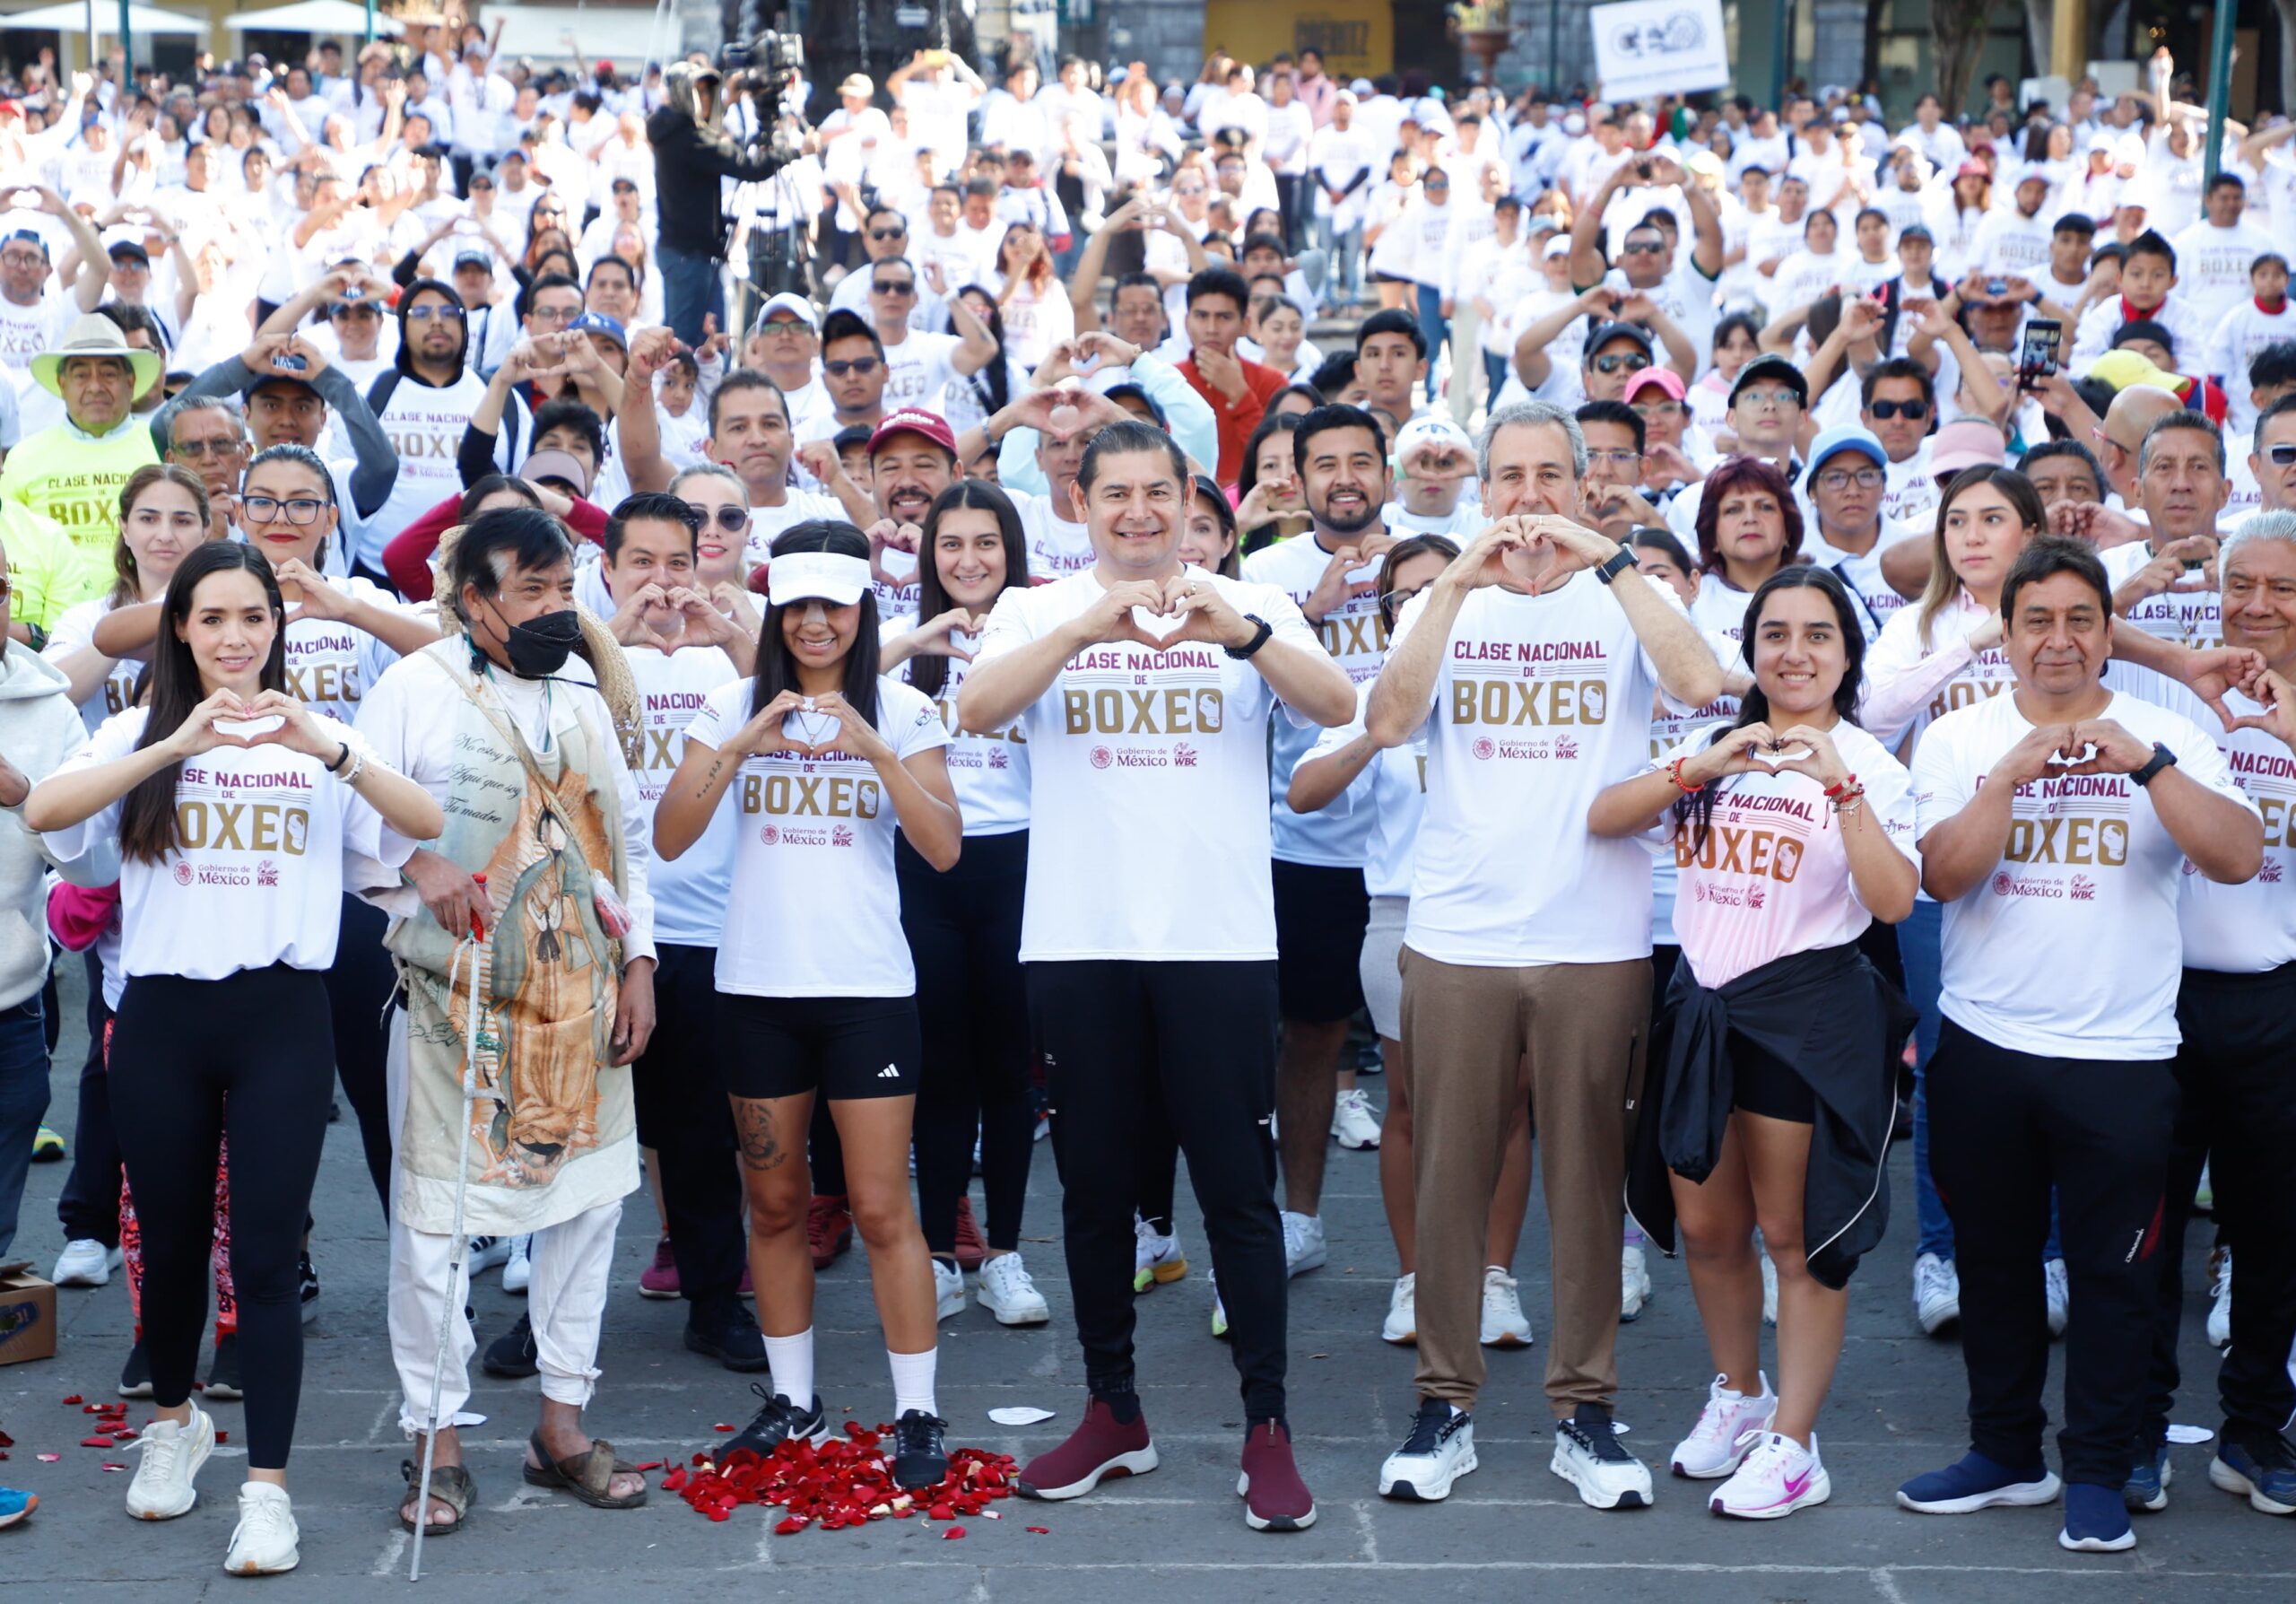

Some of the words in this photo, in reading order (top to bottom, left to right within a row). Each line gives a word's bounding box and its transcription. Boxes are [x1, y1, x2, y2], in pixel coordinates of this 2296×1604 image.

[886, 375, 926, 397] XEO
[384, 412, 422, 422] CLASE
[426, 412, 471, 424] NACION
[2231, 493, 2262, 504] CLAS
[48, 498, 114, 527] BOX
[894, 604, 905, 614] DE
[1347, 603, 1358, 614] DE
[2181, 605, 2221, 621] NACI
[1454, 641, 1513, 660] CLASE
[1518, 641, 1607, 662] NACIONAL
[288, 657, 300, 666] DE
[1065, 652, 1121, 671] CLASE
[1127, 650, 1220, 670] NACIONAL
[1523, 666, 1536, 677] DE
[1984, 669, 1996, 678] DE
[285, 664, 361, 702] XEO
[1134, 675, 1148, 685] DE
[646, 693, 706, 711] NACION
[1452, 679, 1607, 727] BOXEO
[1064, 687, 1223, 734] BOXEO
[654, 714, 665, 725] DE
[1668, 724, 1680, 734] DE
[452, 732, 486, 752] No
[476, 746, 504, 763] estoy
[1499, 739, 1537, 747] Gobierno
[1538, 739, 1549, 747] de
[1116, 747, 1155, 755] Gobierno
[1156, 747, 1168, 755] de
[1499, 746, 1548, 760] México
[1555, 749, 1578, 760] WBC
[988, 760, 1008, 770] WBC
[1117, 754, 1167, 768] México
[1174, 757, 1197, 767] WBC
[2230, 750, 2296, 780] NACION
[804, 763, 816, 773] DE
[214, 771, 313, 789] NACIONAL
[222, 789, 236, 799] DE
[504, 784, 523, 800] soy
[2042, 777, 2131, 798] NACIONAL
[744, 774, 880, 819] BOXEO
[443, 796, 469, 813] Tu
[460, 809, 502, 824] madre
[1728, 793, 1815, 823] NACIONAL
[1728, 812, 1742, 824] DE
[176, 800, 309, 857] OXEO
[782, 827, 817, 835] Gobierno
[782, 833, 826, 846] México
[832, 838, 852, 847] WBC
[2005, 817, 2129, 867] OXEO
[1674, 824, 1805, 884] BOXEO
[197, 863, 239, 874] Gobierno
[240, 864, 251, 874] de
[197, 871, 250, 886] México
[257, 876, 279, 887] WBC
[2258, 872, 2282, 884] WBC
[2012, 884, 2064, 898] México
[2070, 888, 2095, 900] WBC
